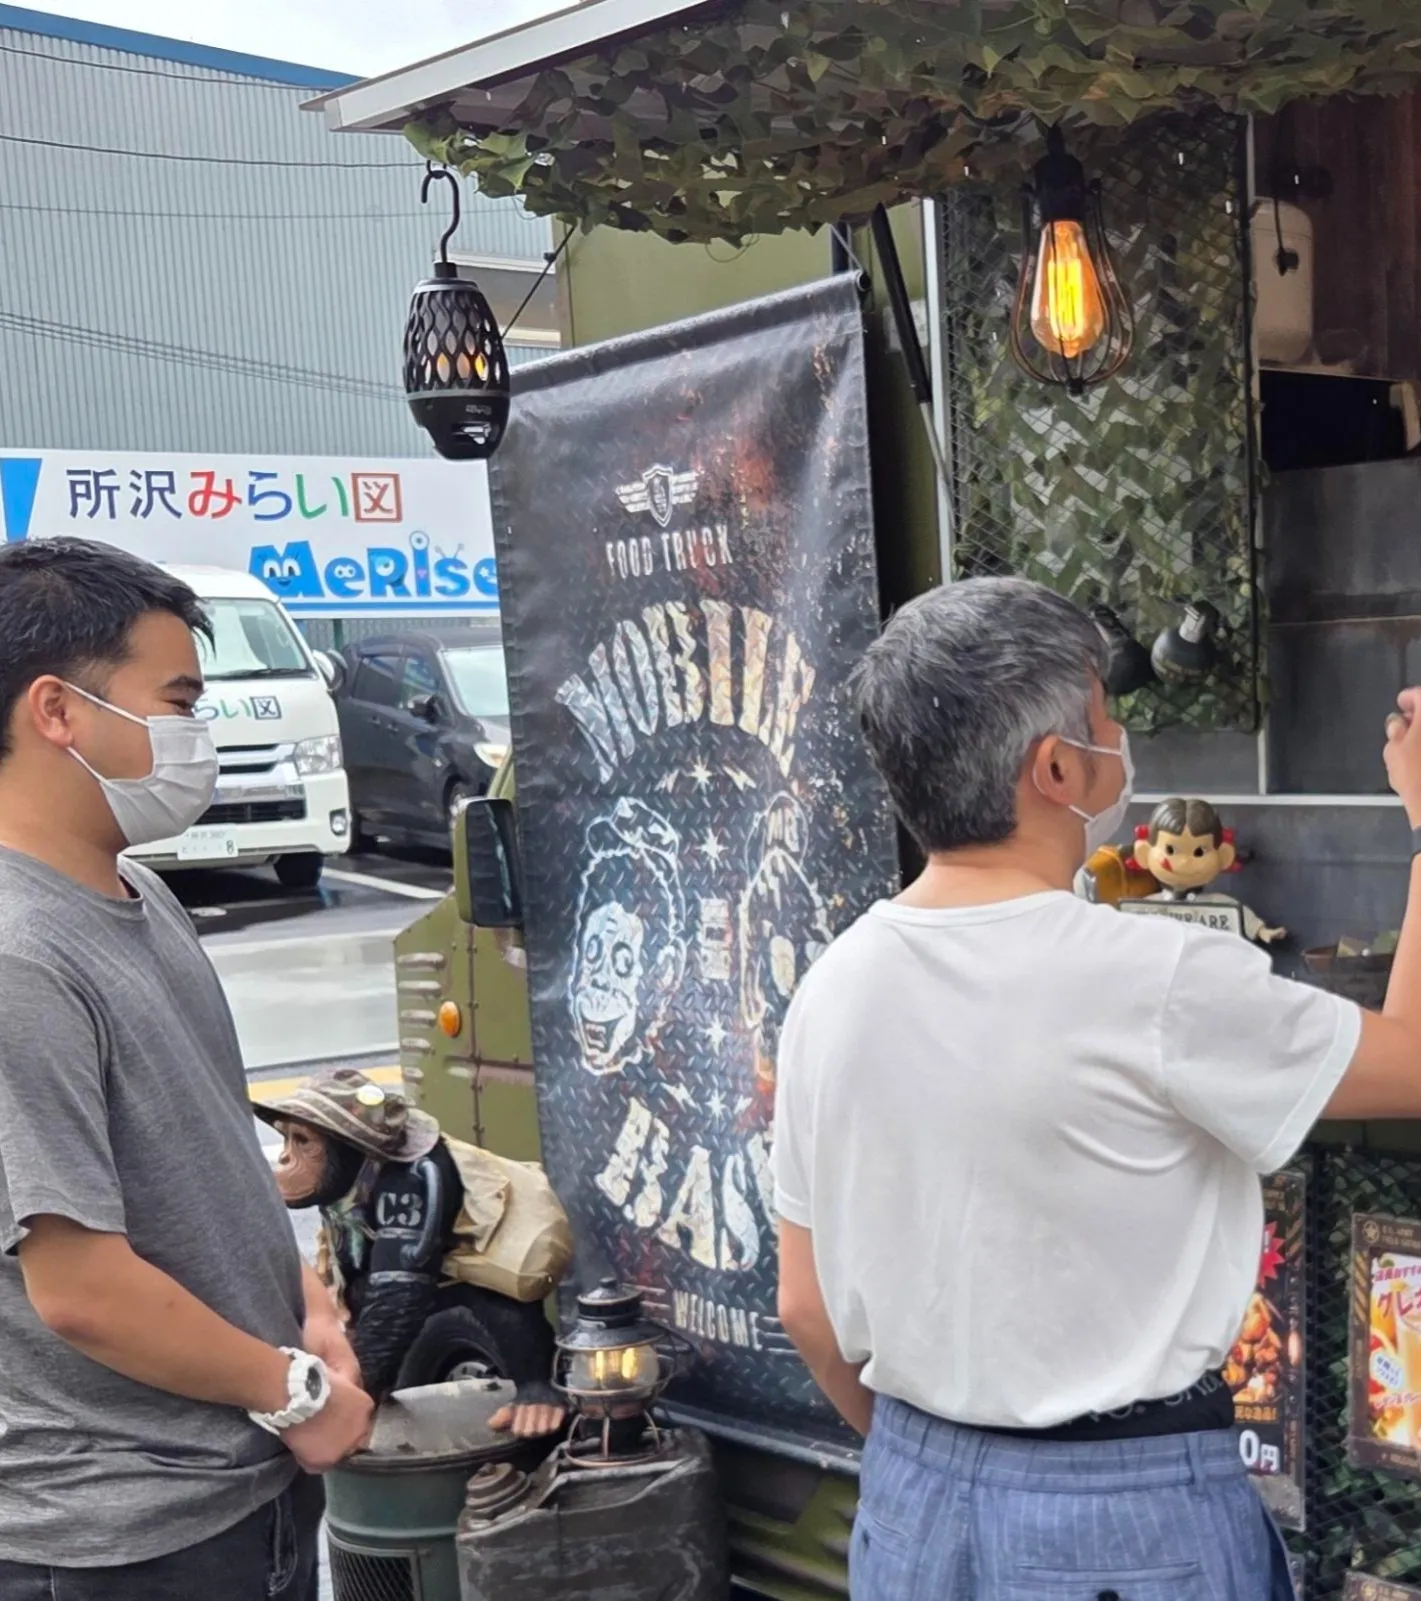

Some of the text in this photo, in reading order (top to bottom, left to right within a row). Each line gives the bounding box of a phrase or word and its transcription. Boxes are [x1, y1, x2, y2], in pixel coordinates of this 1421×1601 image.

[66, 468, 403, 523] 所沢みらい図
[605, 523, 734, 580] FOOD TRUCK
[554, 598, 816, 785] MOBILE
[375, 1191, 424, 1228] C3
[673, 1288, 763, 1352] WELCOME
